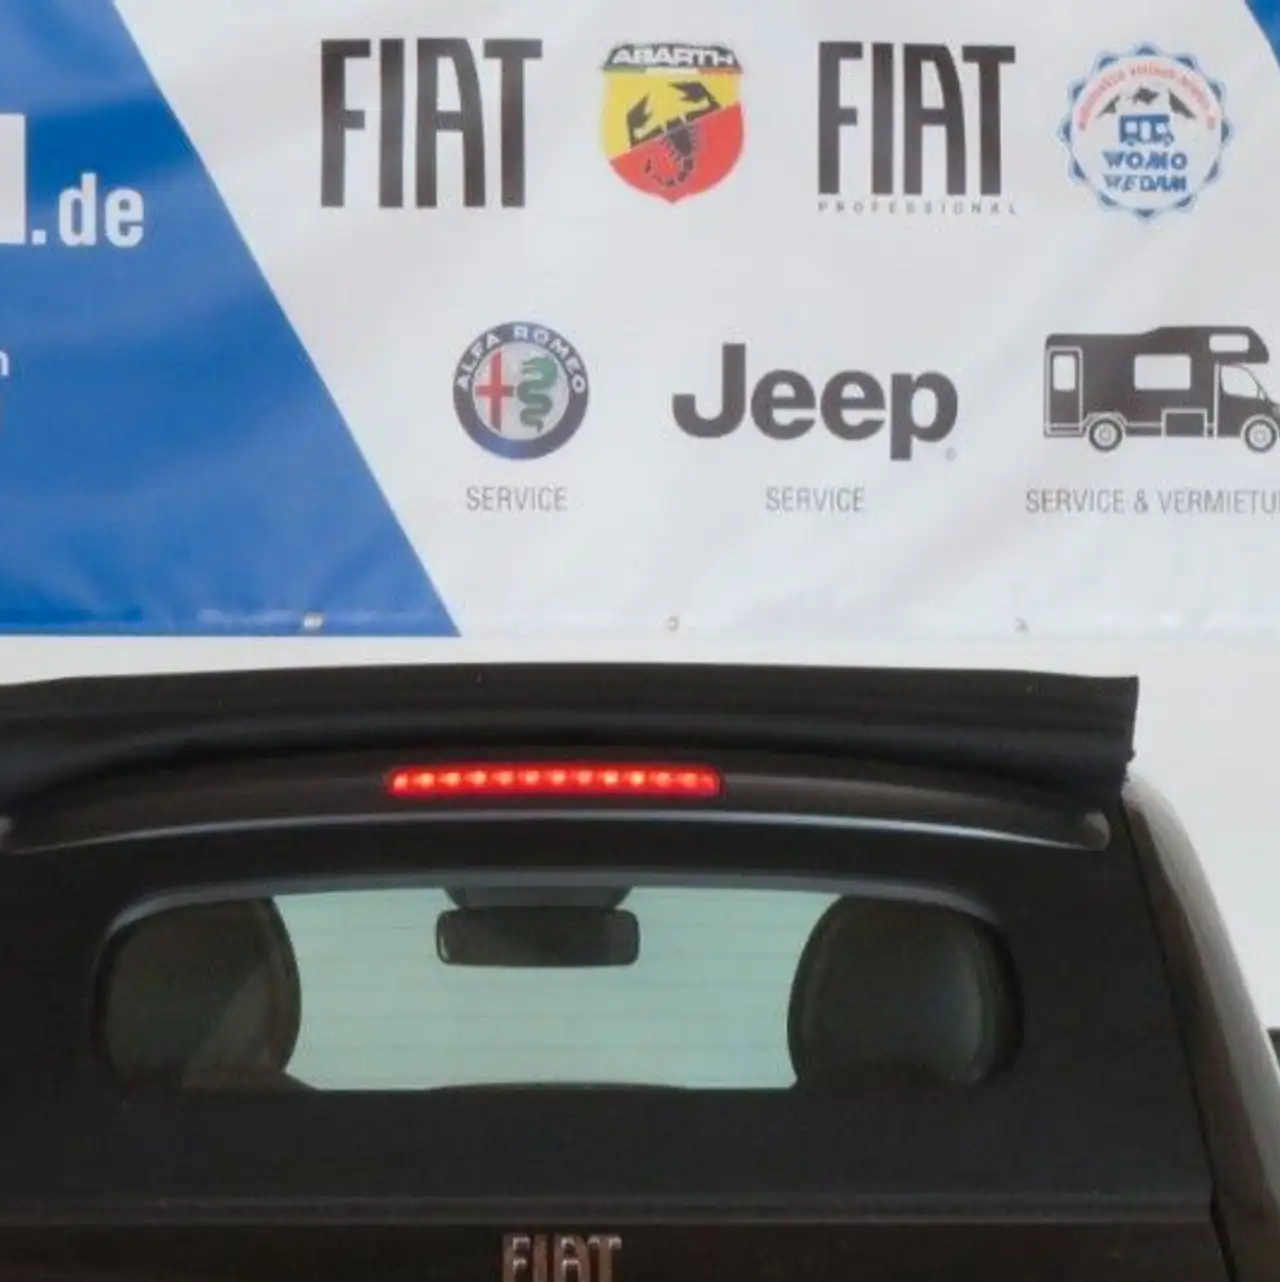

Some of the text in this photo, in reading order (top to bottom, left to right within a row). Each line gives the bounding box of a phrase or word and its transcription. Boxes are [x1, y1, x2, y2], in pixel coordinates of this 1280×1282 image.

[612, 45, 735, 66] ABARTH
[320, 38, 543, 208] FIAT
[819, 41, 1016, 195] FIAT
[1102, 151, 1188, 170] WOMO
[818, 201, 1017, 214] PROFESSIONAL
[458, 325, 586, 393] ALFA ROMEO
[672, 342, 959, 462] Jeep
[466, 486, 568, 512] SERVICE
[765, 487, 865, 513] SERVICE
[1026, 488, 1125, 515] SERVICE
[1134, 489, 1150, 514] &
